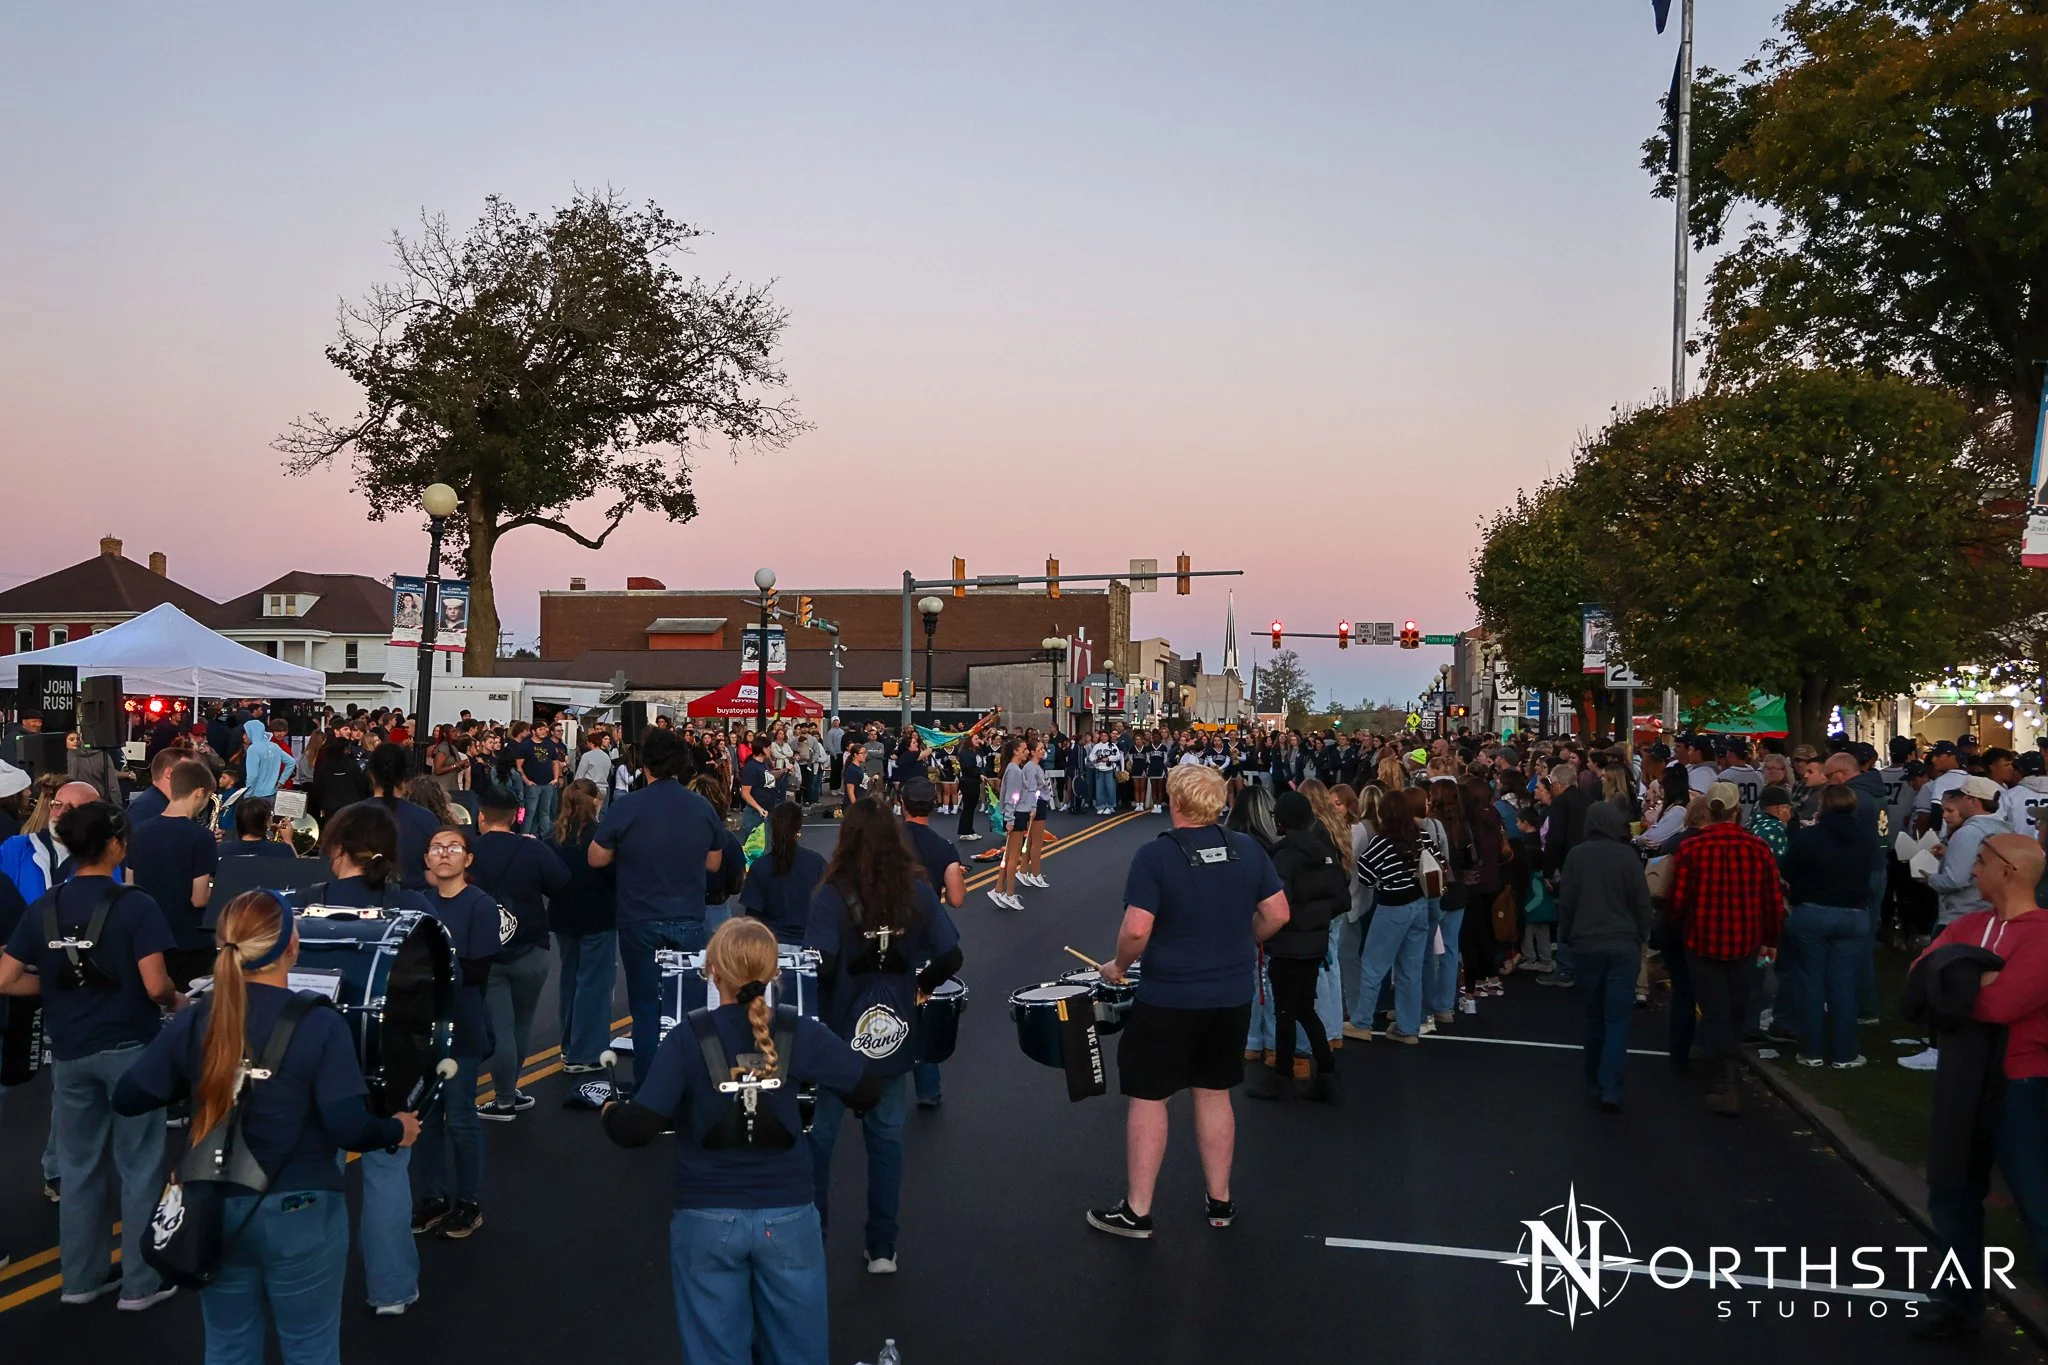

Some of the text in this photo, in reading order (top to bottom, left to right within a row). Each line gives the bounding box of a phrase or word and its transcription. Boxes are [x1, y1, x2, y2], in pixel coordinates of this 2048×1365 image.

[43, 680, 73, 694] JOHN
[43, 696, 73, 710] RUSH
[1422, 720, 1436, 729] 322
[1968, 736, 1977, 744] C
[853, 1023, 907, 1050] Bands
[1087, 1025, 1104, 1084] VIC FIRTH
[581, 1085, 611, 1097] ands
